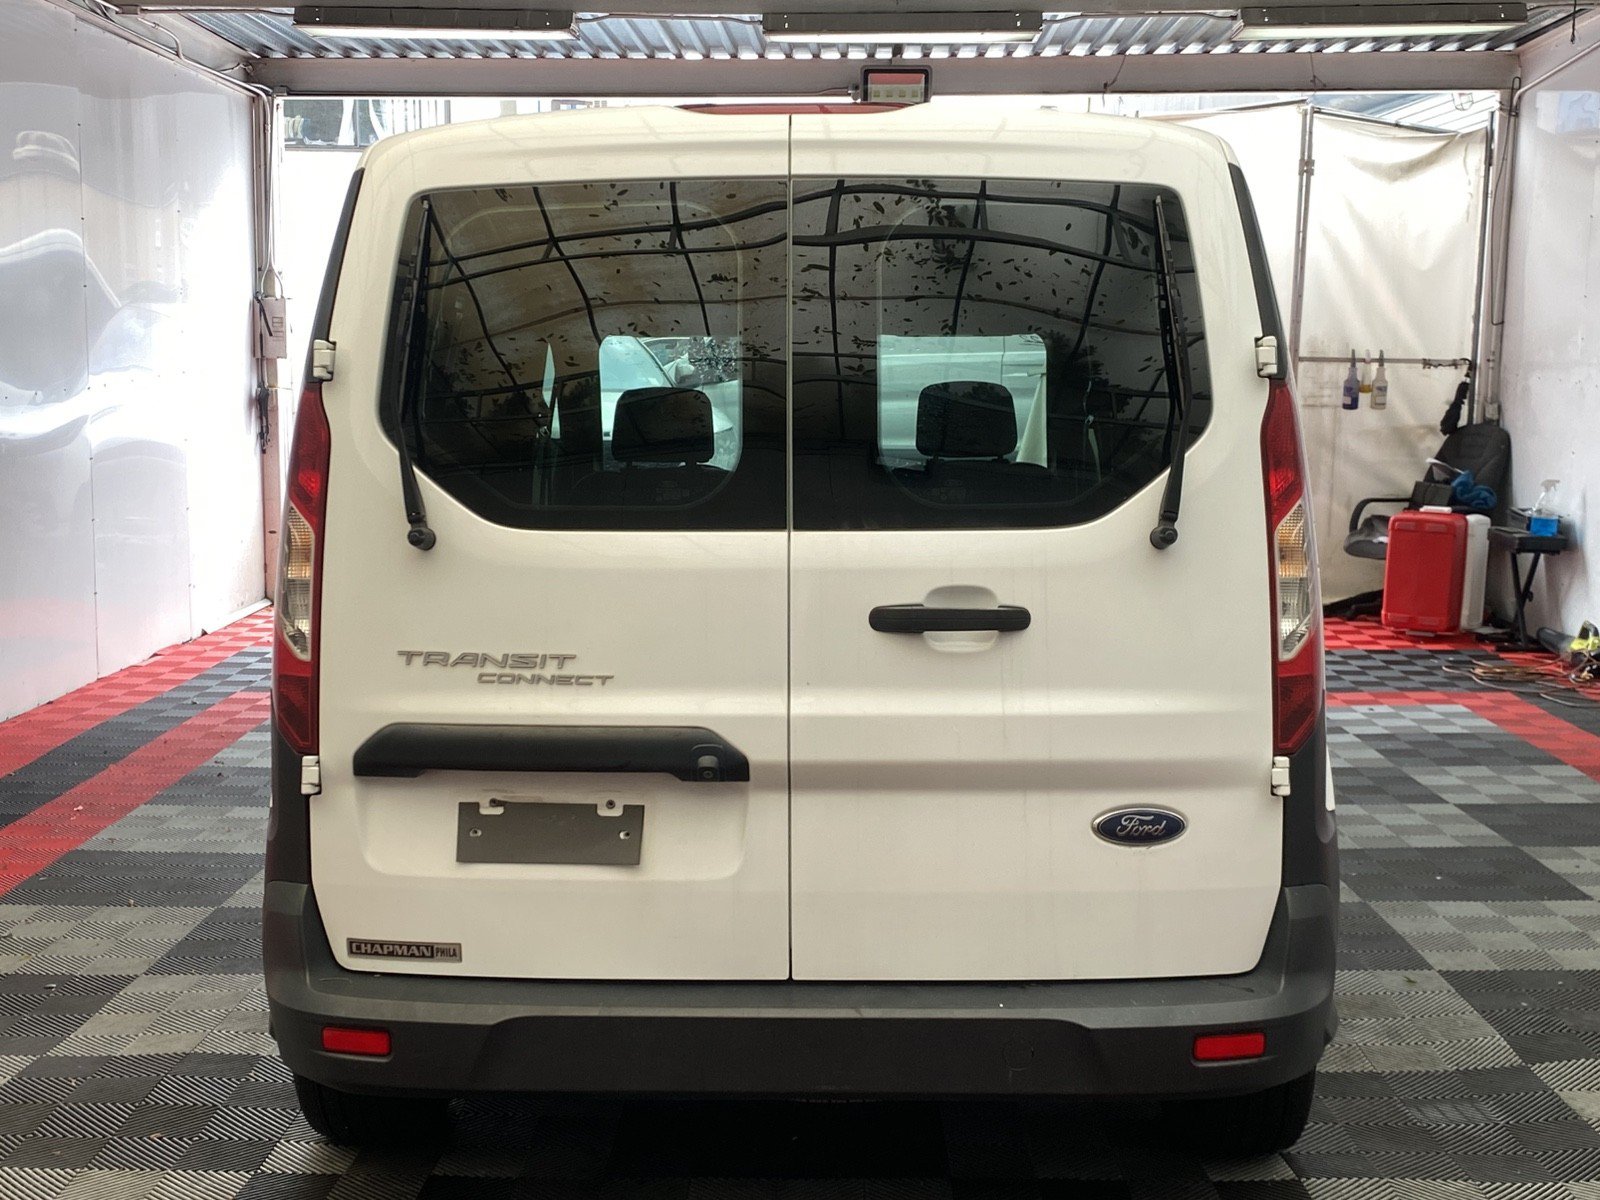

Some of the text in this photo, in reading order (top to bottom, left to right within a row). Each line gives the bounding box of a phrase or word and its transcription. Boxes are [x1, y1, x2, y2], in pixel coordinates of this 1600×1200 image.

[397, 650, 577, 669] TRANSIT
[477, 672, 615, 687] CONNECT
[1116, 814, 1167, 837] Ford
[351, 942, 458, 958] CHAPMAN PHILA
